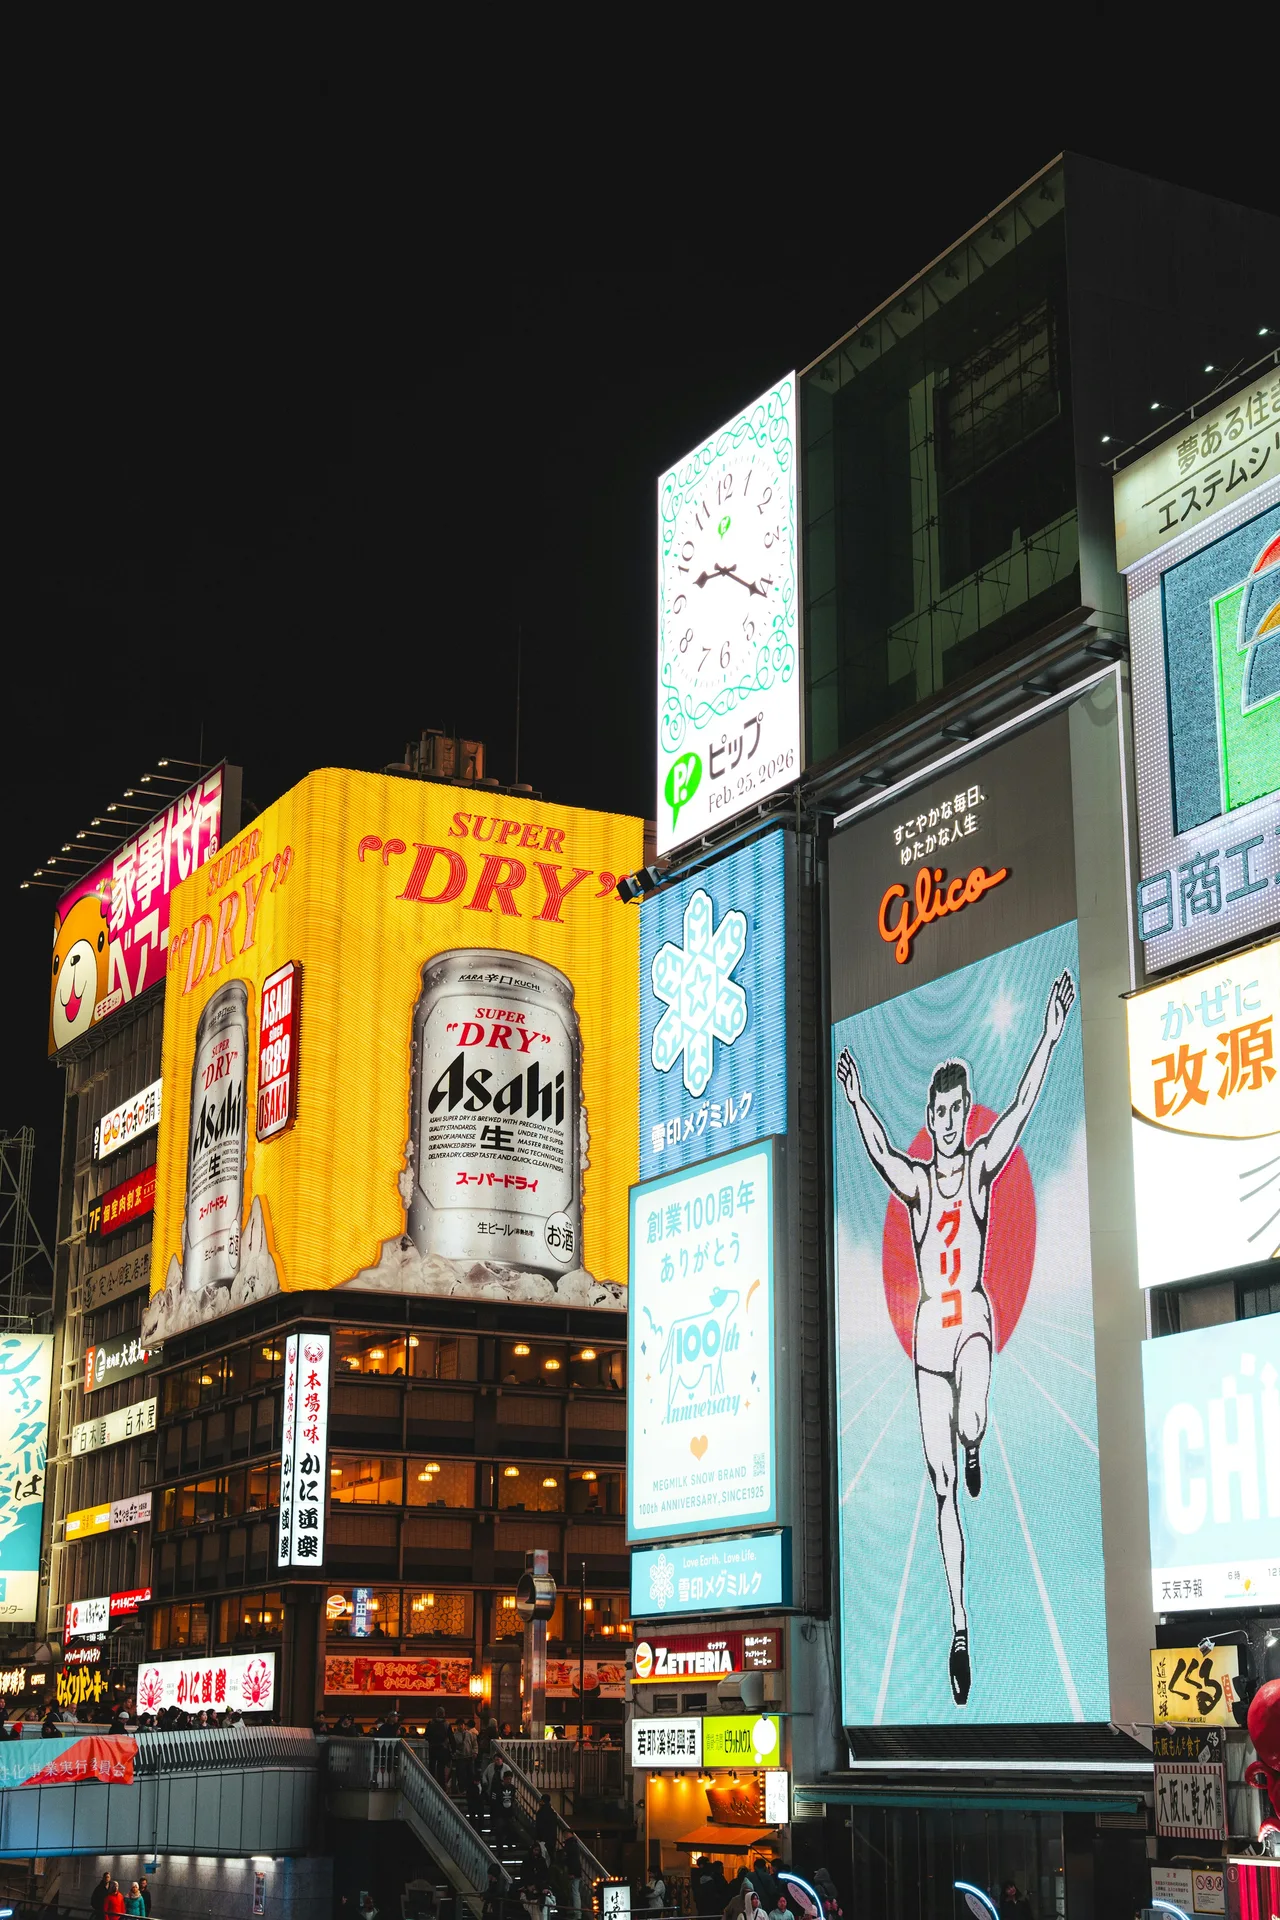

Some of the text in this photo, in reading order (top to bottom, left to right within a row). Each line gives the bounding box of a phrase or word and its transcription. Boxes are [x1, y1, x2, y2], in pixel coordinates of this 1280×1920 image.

[716, 473, 733, 502] 12
[742, 468, 754, 497] 1
[757, 486, 772, 515] 2
[694, 500, 712, 532] 11
[763, 526, 781, 549] 3
[677, 540, 695, 574] 10
[757, 573, 775, 599] 4
[672, 593, 688, 615] 9
[679, 627, 694, 654] 8
[743, 612, 756, 641] 5
[697, 645, 712, 672] 7
[718, 639, 732, 669] 6
[709, 711, 764, 780] ピップ
[708, 786, 735, 813] Feb.
[758, 748, 794, 783] 2026
[893, 784, 986, 846] すこやかな毎日、
[448, 811, 567, 854] SUPER
[901, 813, 977, 865] ゆたかな人生
[110, 769, 222, 932] 家事代行
[207, 827, 262, 897] SUPER
[877, 866, 1008, 965] Glico
[459, 974, 483, 982] KARA
[484, 973, 514, 985] 辛口
[514, 979, 541, 991] KUCHI
[262, 976, 294, 1031] ASAHI
[475, 1007, 526, 1024] SUPER
[1160, 978, 1263, 1042] かぜに
[268, 1023, 284, 1043] since
[211, 1038, 230, 1059] SUPER
[260, 1033, 291, 1087] 1889
[1151, 1014, 1278, 1118] 改源
[428, 1051, 565, 1126] Asahi
[257, 1080, 287, 1132] OSAKA
[194, 1080, 242, 1163] Asahi
[477, 1115, 502, 1123] BREWED
[502, 1118, 518, 1126] WITH
[519, 1120, 547, 1131] PRECISION
[517, 1129, 538, 1139] UNDER
[538, 1133, 549, 1142] THE
[651, 1091, 753, 1154] 雪印メグミルク
[480, 1125, 515, 1153] 生
[517, 1138, 541, 1149] MASTER
[208, 1153, 222, 1180] 生
[479, 1152, 497, 1160] TASTE
[497, 1153, 511, 1161] AND
[532, 1159, 549, 1169] CLEAN
[517, 1147, 530, 1155] ING
[530, 1149, 564, 1165] TECHNIQUES
[456, 1172, 539, 1193] スーパードライ
[89, 1206, 101, 1234] 7F
[198, 1194, 229, 1221] スーパードライ
[646, 1180, 756, 1244] 創業100周年
[477, 1221, 514, 1237] 生ビール
[547, 1224, 574, 1253] お酒
[660, 1231, 741, 1284] ありがとう
[936, 1200, 963, 1329] グリコ
[676, 1318, 741, 1366] 100th
[285, 1372, 296, 1445] 本場の味
[304, 1369, 322, 1445] 本場の味
[661, 1392, 742, 1426] Anniversary
[80, 1404, 155, 1453] 白木屋 白木屋
[652, 1466, 747, 1492] MEGMILK SNOW BRAND
[297, 1452, 321, 1559] かに道楽
[639, 1503, 658, 1515] 100th
[683, 1549, 757, 1569] Love Earth. Love Life.
[678, 1569, 763, 1603] 雪印メグミルク
[1161, 1578, 1203, 1600] 天気予報
[655, 1648, 733, 1676] ZETTERIA
[753, 1658, 772, 1666] コーヒー
[177, 1668, 227, 1705] かに道楽
[1156, 1657, 1168, 1717] 道頓堀
[1168, 1658, 1222, 1715] くくる
[724, 1729, 752, 1753] ピタットハウス
[1154, 1735, 1201, 1757] 大阪もんを食す
[1159, 1775, 1214, 1827] 大阪に乾杯
